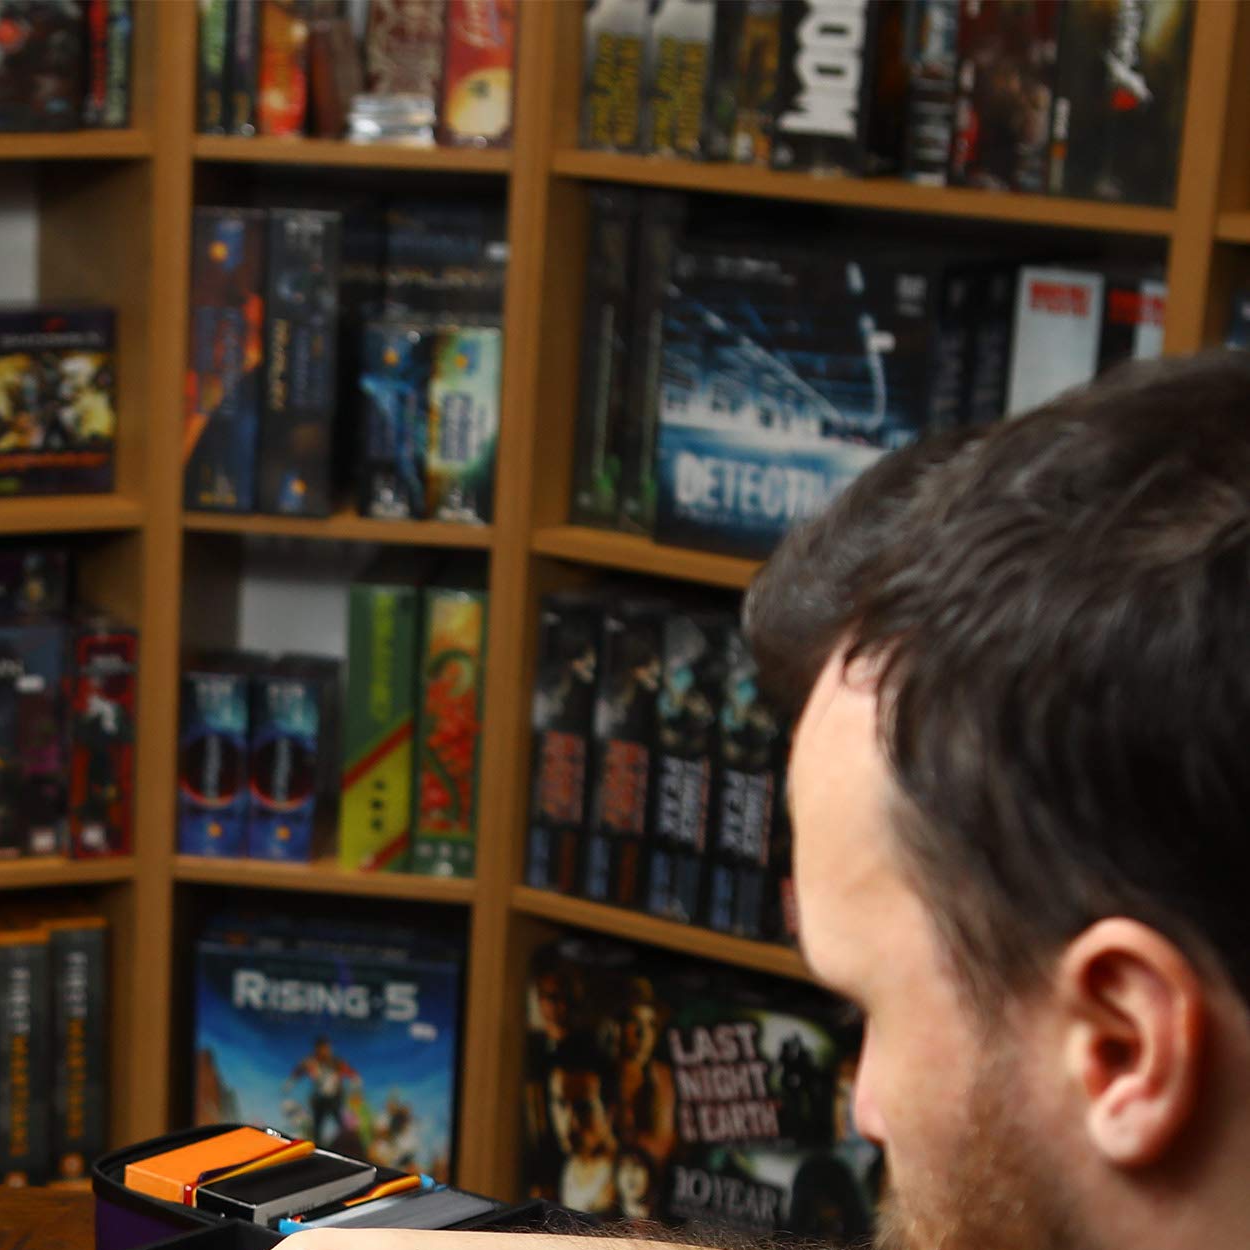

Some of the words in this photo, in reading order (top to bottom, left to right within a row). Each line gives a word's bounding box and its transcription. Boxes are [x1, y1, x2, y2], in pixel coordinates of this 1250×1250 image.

[779, 0, 867, 138] OOM
[230, 969, 371, 1019] RISING
[384, 981, 419, 1022] 5
[668, 1022, 758, 1067] LAST
[675, 1062, 768, 1101] NIGHT
[699, 1099, 782, 1143] EARTH
